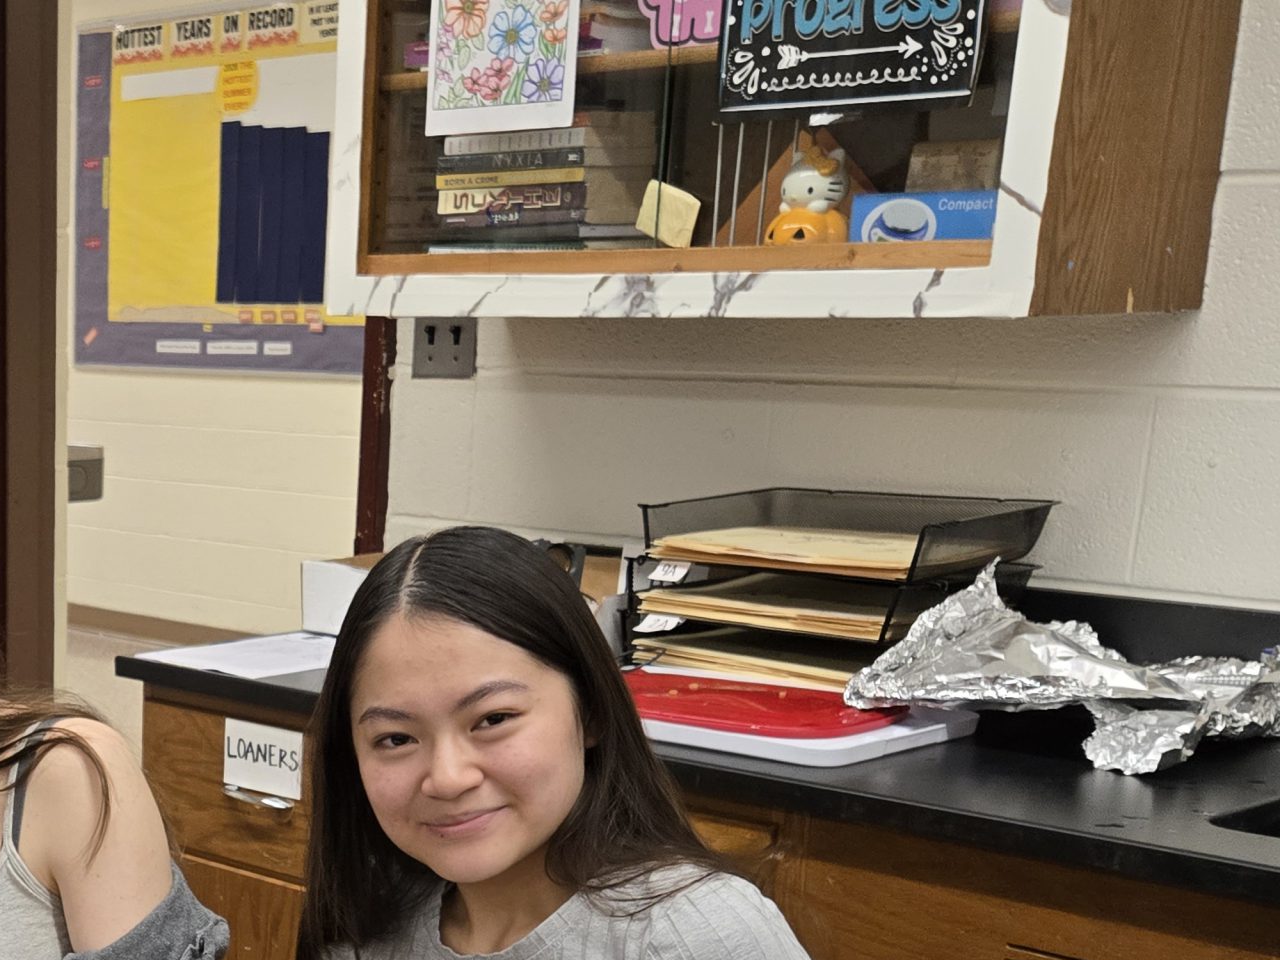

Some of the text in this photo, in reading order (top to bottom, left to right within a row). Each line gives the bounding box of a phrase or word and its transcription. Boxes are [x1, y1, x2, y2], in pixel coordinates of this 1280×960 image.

[116, 7, 295, 50] HOTTEST YEARS ON RECORD
[492, 152, 543, 168] NYXIA
[445, 178, 466, 187] BORN
[938, 198, 994, 212] Compact
[227, 734, 299, 772] LOANERS
